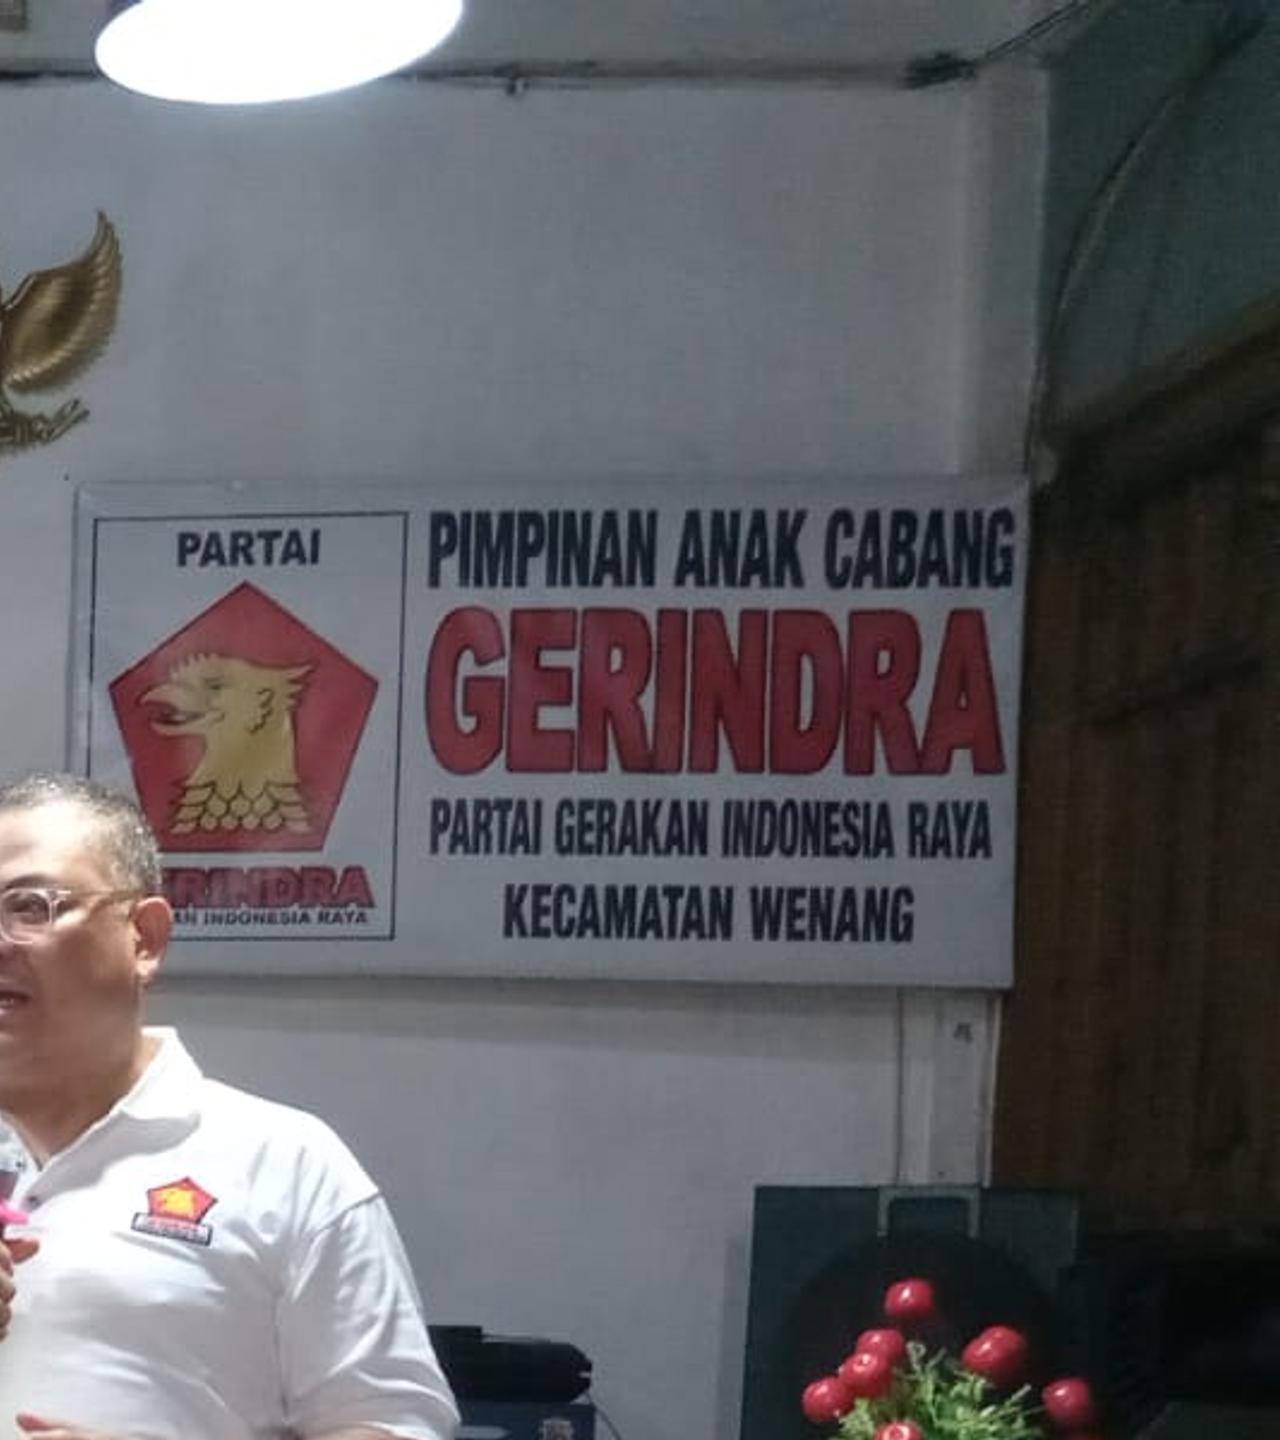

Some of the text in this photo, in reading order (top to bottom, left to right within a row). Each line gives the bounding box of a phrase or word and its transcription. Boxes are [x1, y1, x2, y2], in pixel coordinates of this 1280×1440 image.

[177, 529, 321, 567] PARTAI
[428, 507, 1015, 589] PIMPINAN ANAK CABANG
[425, 606, 1006, 777] GERINDRA
[429, 798, 993, 859] PARTAI GERAKAN INDONESIA RAYA
[162, 865, 376, 909] RINDRA
[502, 883, 914, 942] KECAMATAN WENANG
[204, 909, 310, 927] INDONESIA
[317, 909, 368, 926] RAYA
